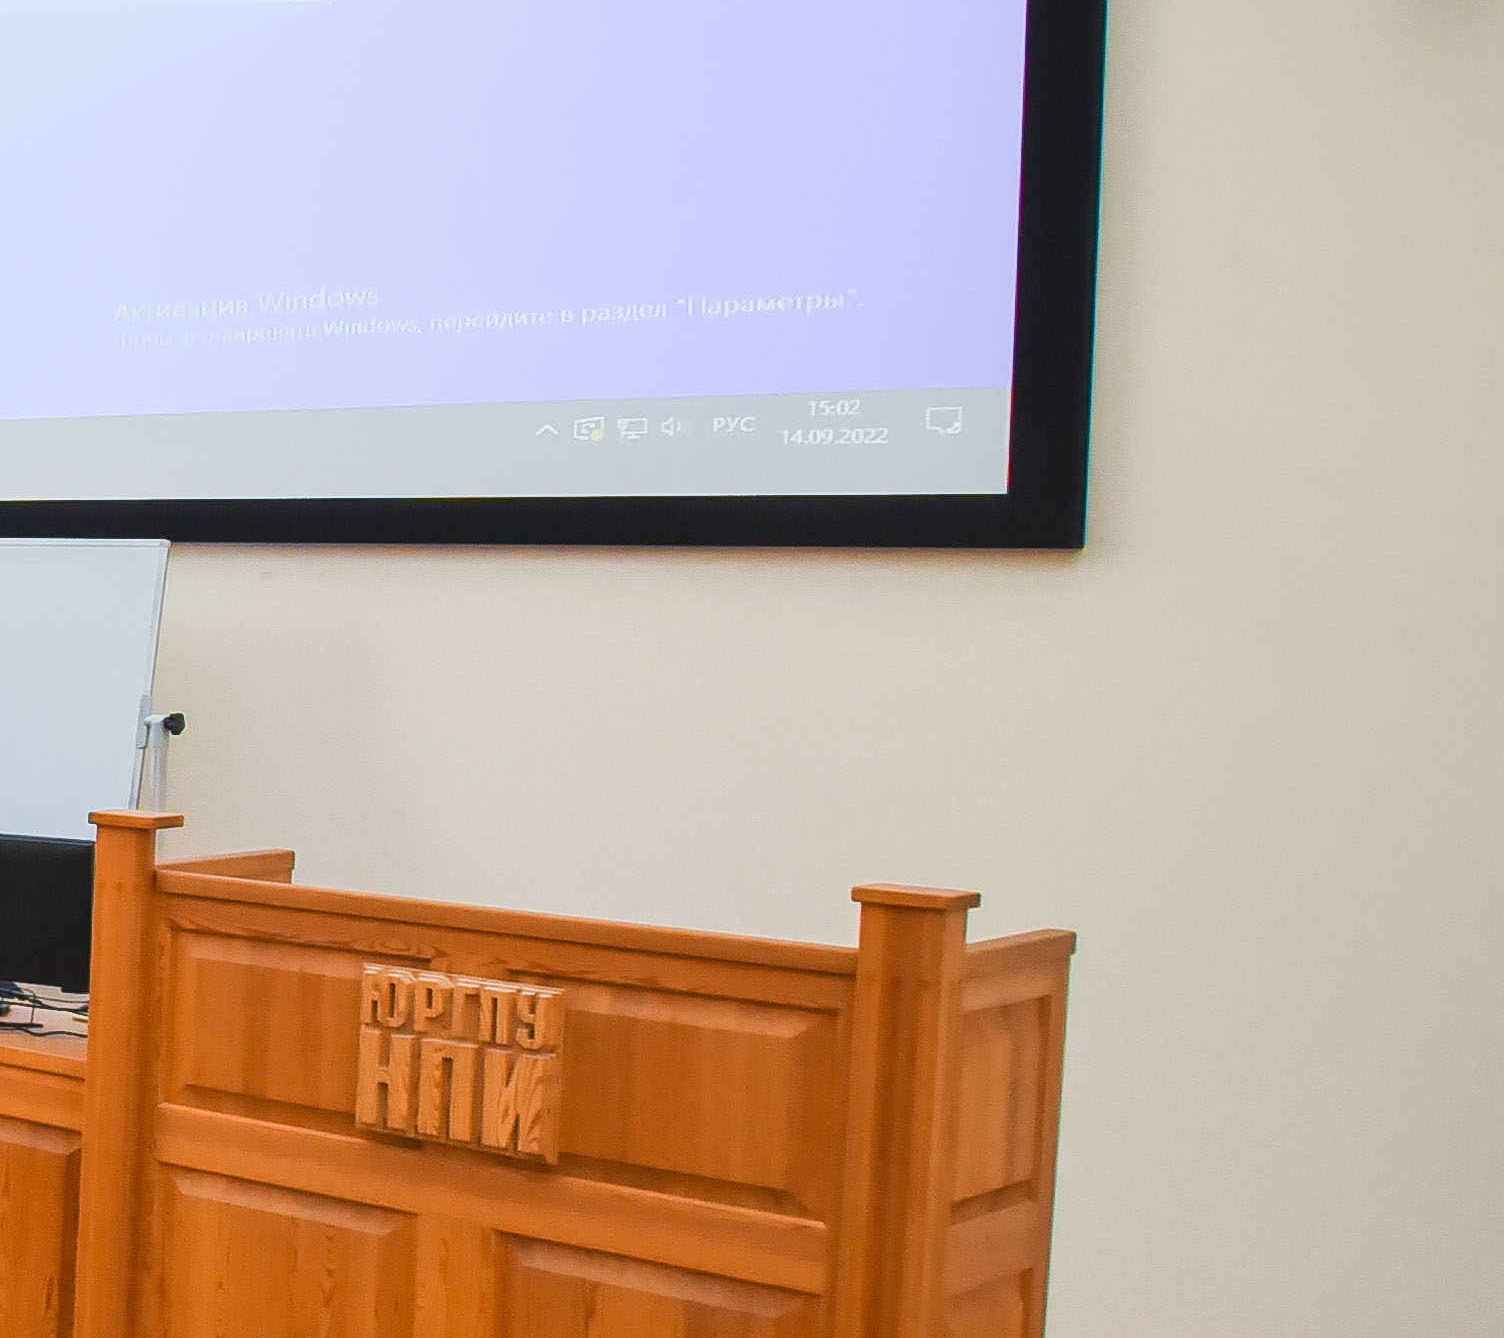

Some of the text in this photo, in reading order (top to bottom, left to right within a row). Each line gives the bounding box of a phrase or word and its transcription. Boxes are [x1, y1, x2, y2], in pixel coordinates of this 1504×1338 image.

[113, 287, 379, 321] Активация Windows
[324, 316, 422, 335] Windows,
[430, 309, 553, 332] перейдите
[582, 304, 667, 325] раздел
[808, 399, 862, 416] 15:02
[712, 416, 757, 433] РУС
[782, 427, 889, 445] 14.09.2022
[362, 963, 565, 1049] ЮРГПУ
[356, 1025, 561, 1165] НПИ
